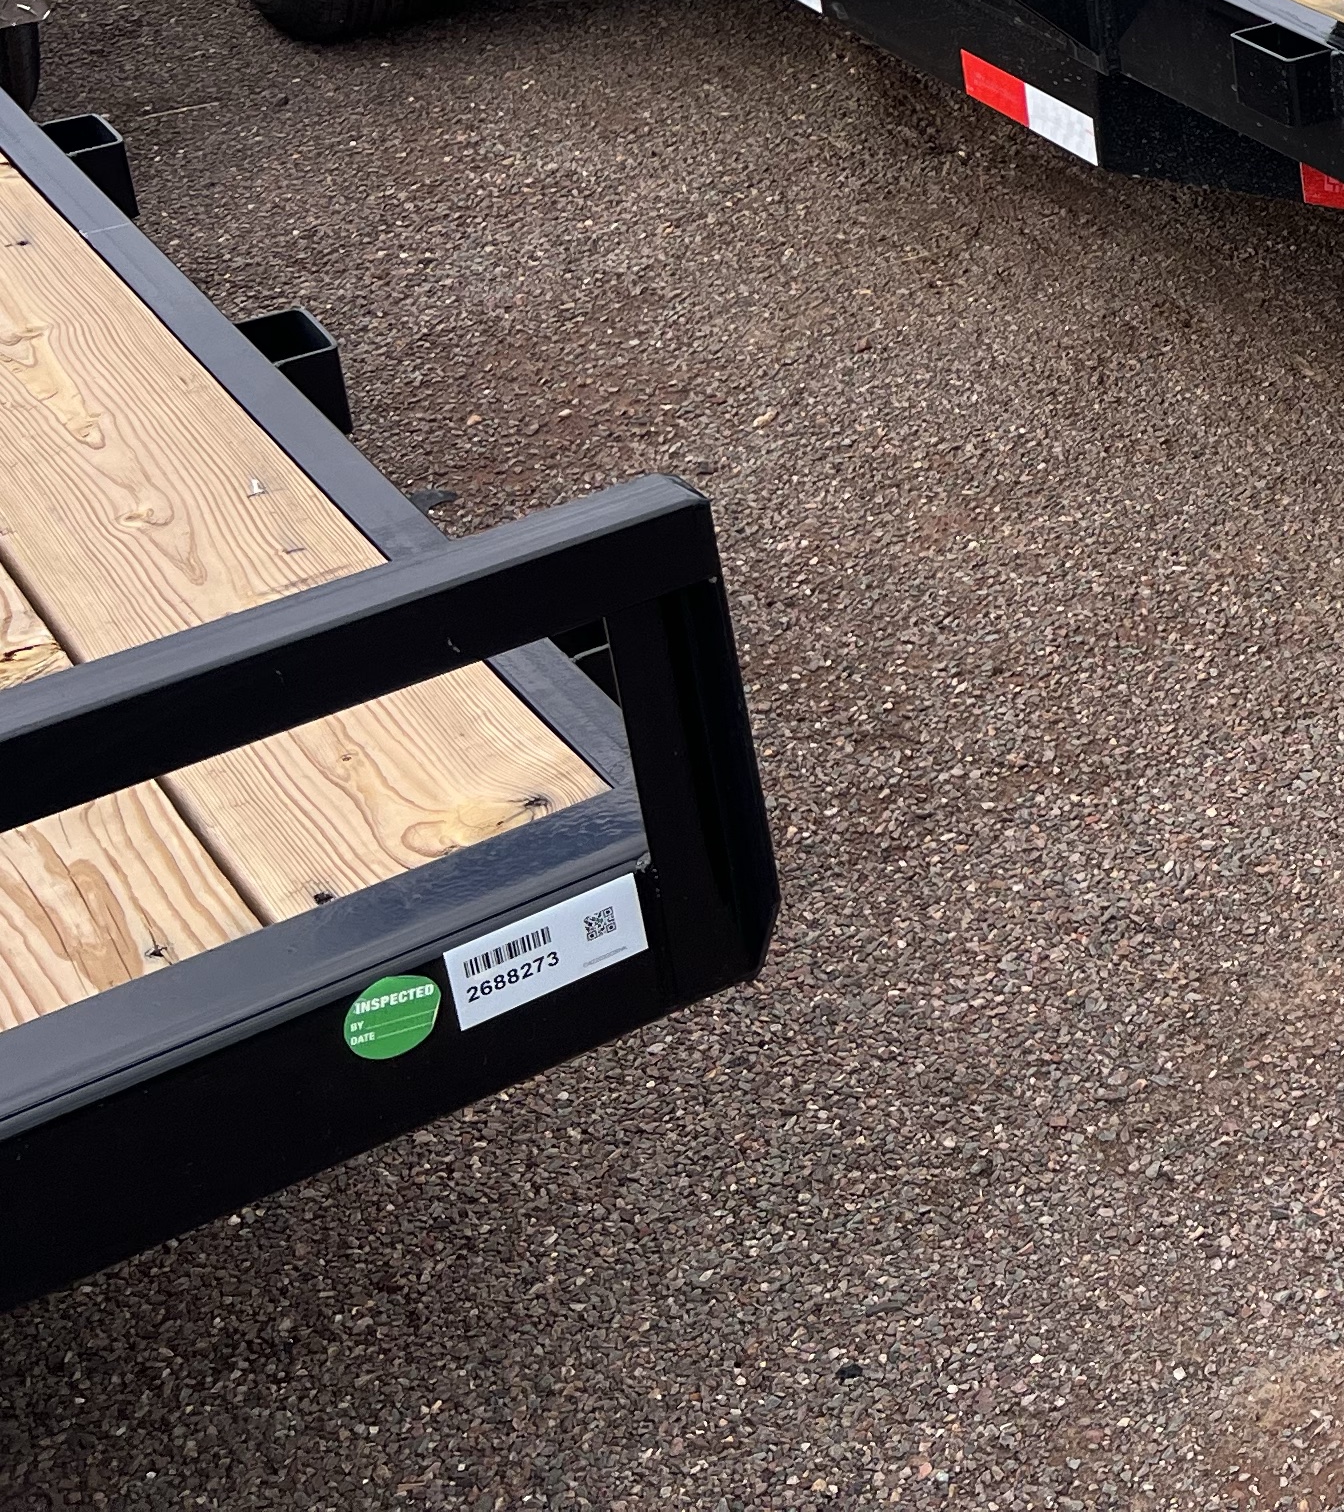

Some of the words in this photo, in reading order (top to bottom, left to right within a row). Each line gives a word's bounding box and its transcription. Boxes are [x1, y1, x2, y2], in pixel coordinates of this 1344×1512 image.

[466, 950, 561, 1004] 2688273
[354, 983, 435, 1015] INSPECTED
[350, 1021, 365, 1033] BY
[350, 1031, 376, 1047] DATE
